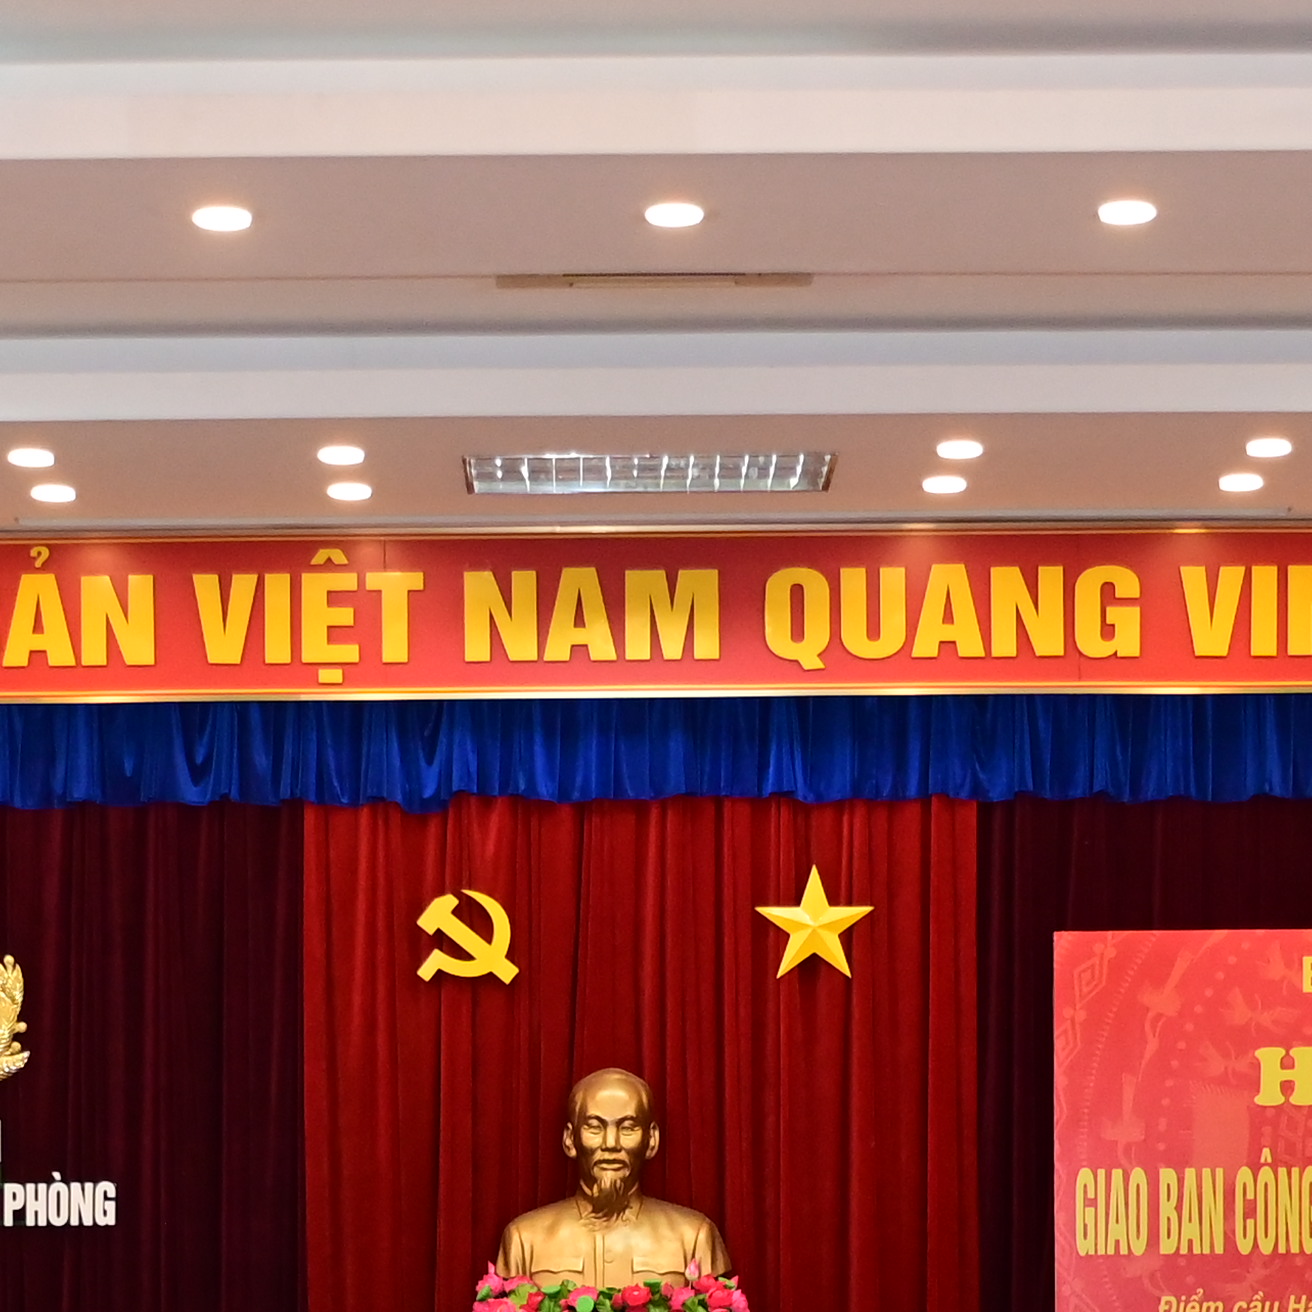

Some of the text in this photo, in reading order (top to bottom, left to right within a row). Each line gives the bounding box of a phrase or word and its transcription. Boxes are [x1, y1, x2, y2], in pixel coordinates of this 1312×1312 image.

[193, 547, 423, 684] VIỆT
[463, 567, 719, 663] NAM
[764, 562, 1141, 672] QUANG
[3, 1172, 117, 1226] PHÒNG
[1076, 1167, 1148, 1256] GIAO
[1159, 1168, 1224, 1254] BAN
